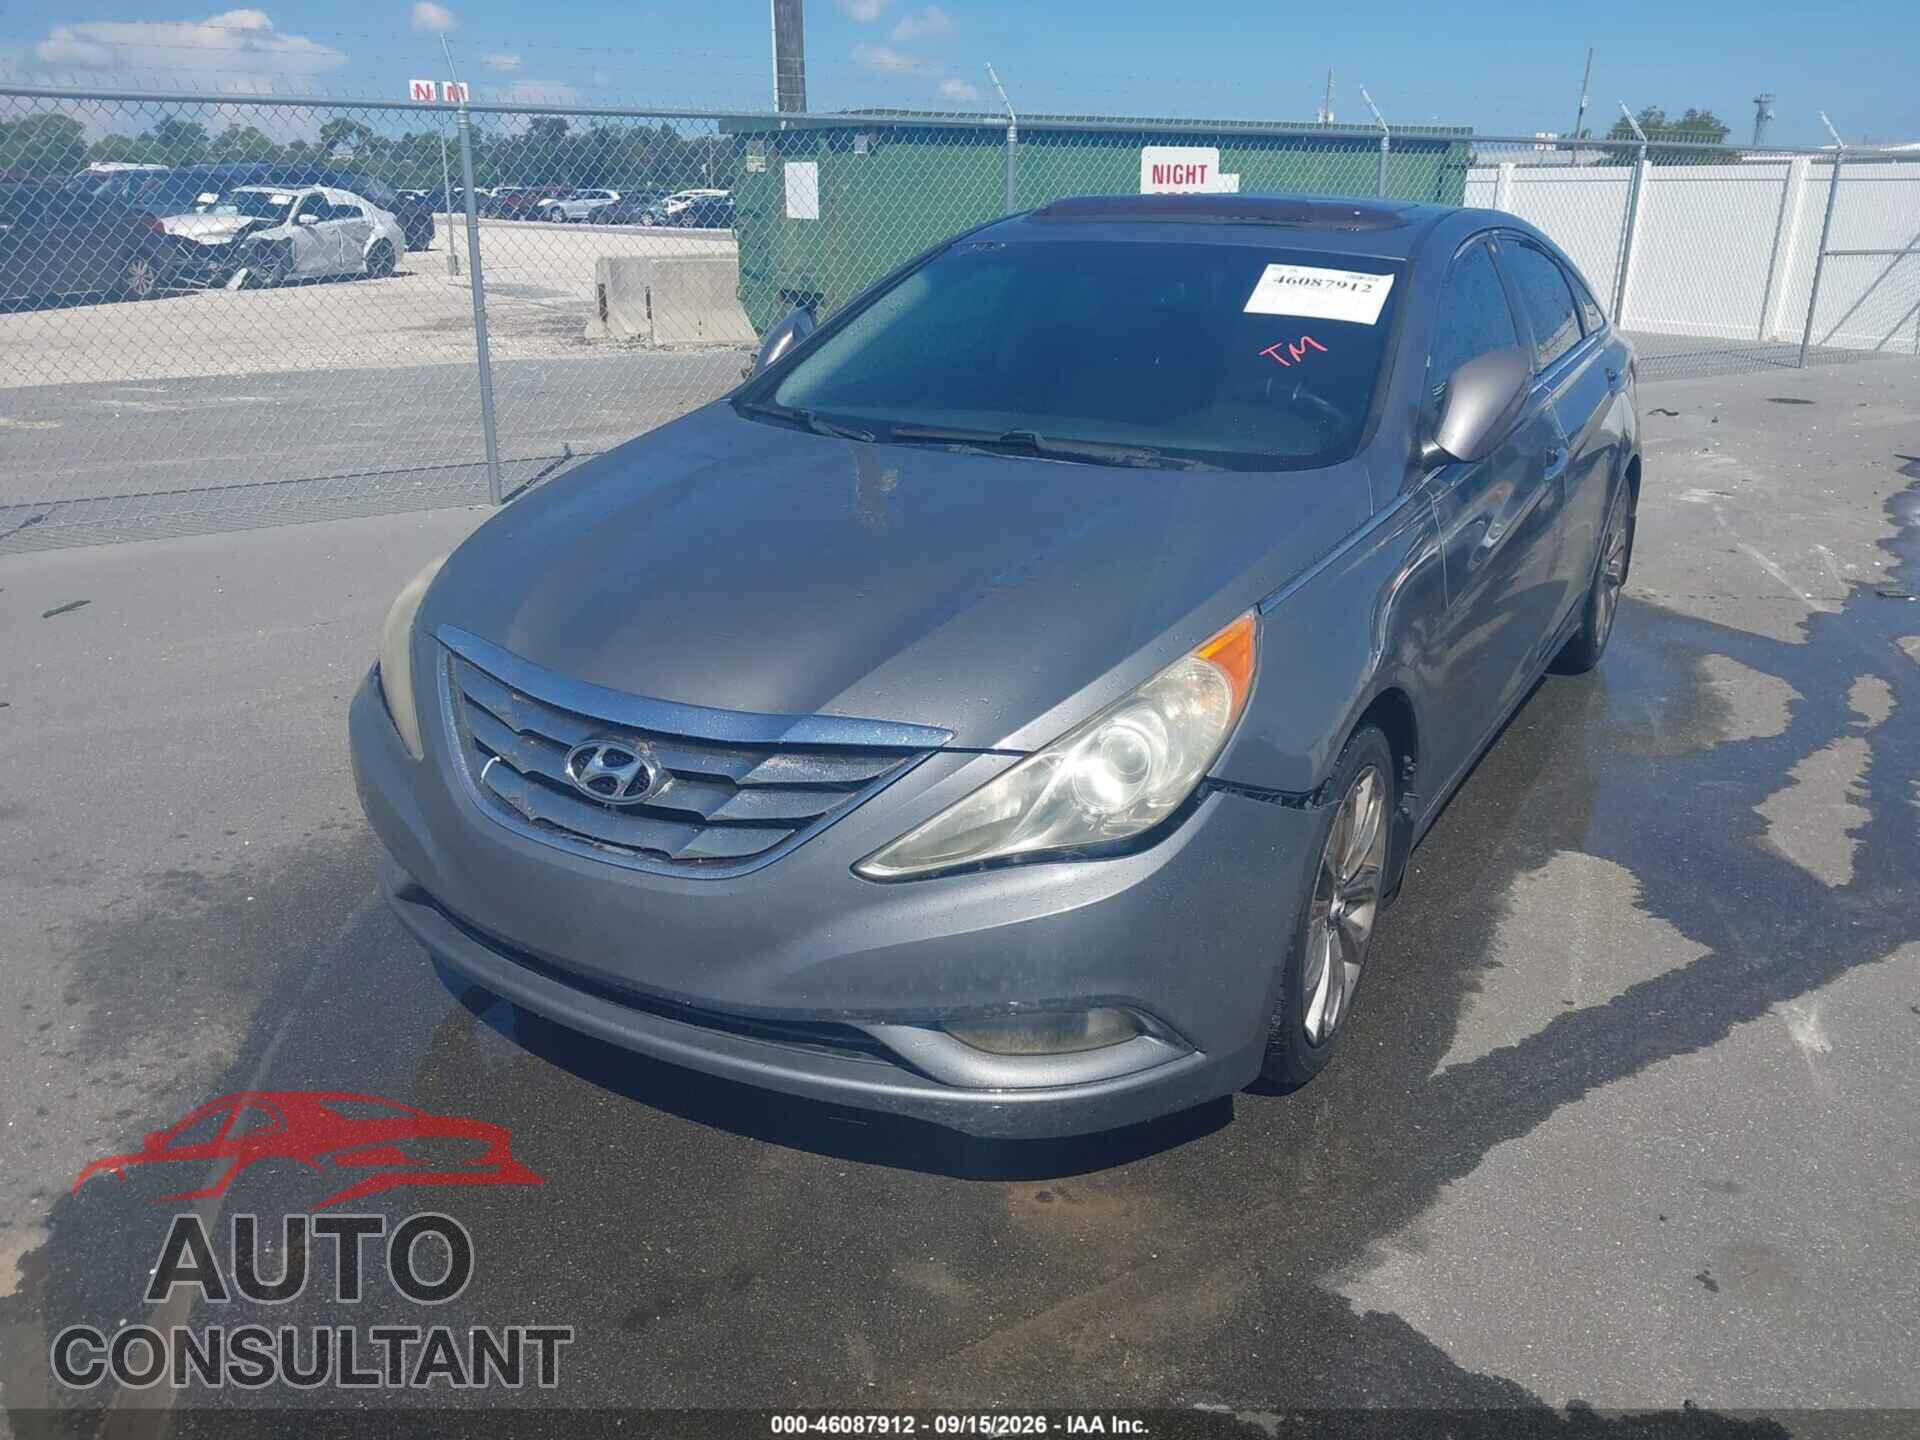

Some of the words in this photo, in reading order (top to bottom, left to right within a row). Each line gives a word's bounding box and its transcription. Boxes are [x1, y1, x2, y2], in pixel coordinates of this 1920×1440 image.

[415, 83, 432, 101] N
[1152, 164, 1208, 185] NIGHT
[1273, 275, 1373, 293] 46087912
[1258, 336, 1328, 366] TM
